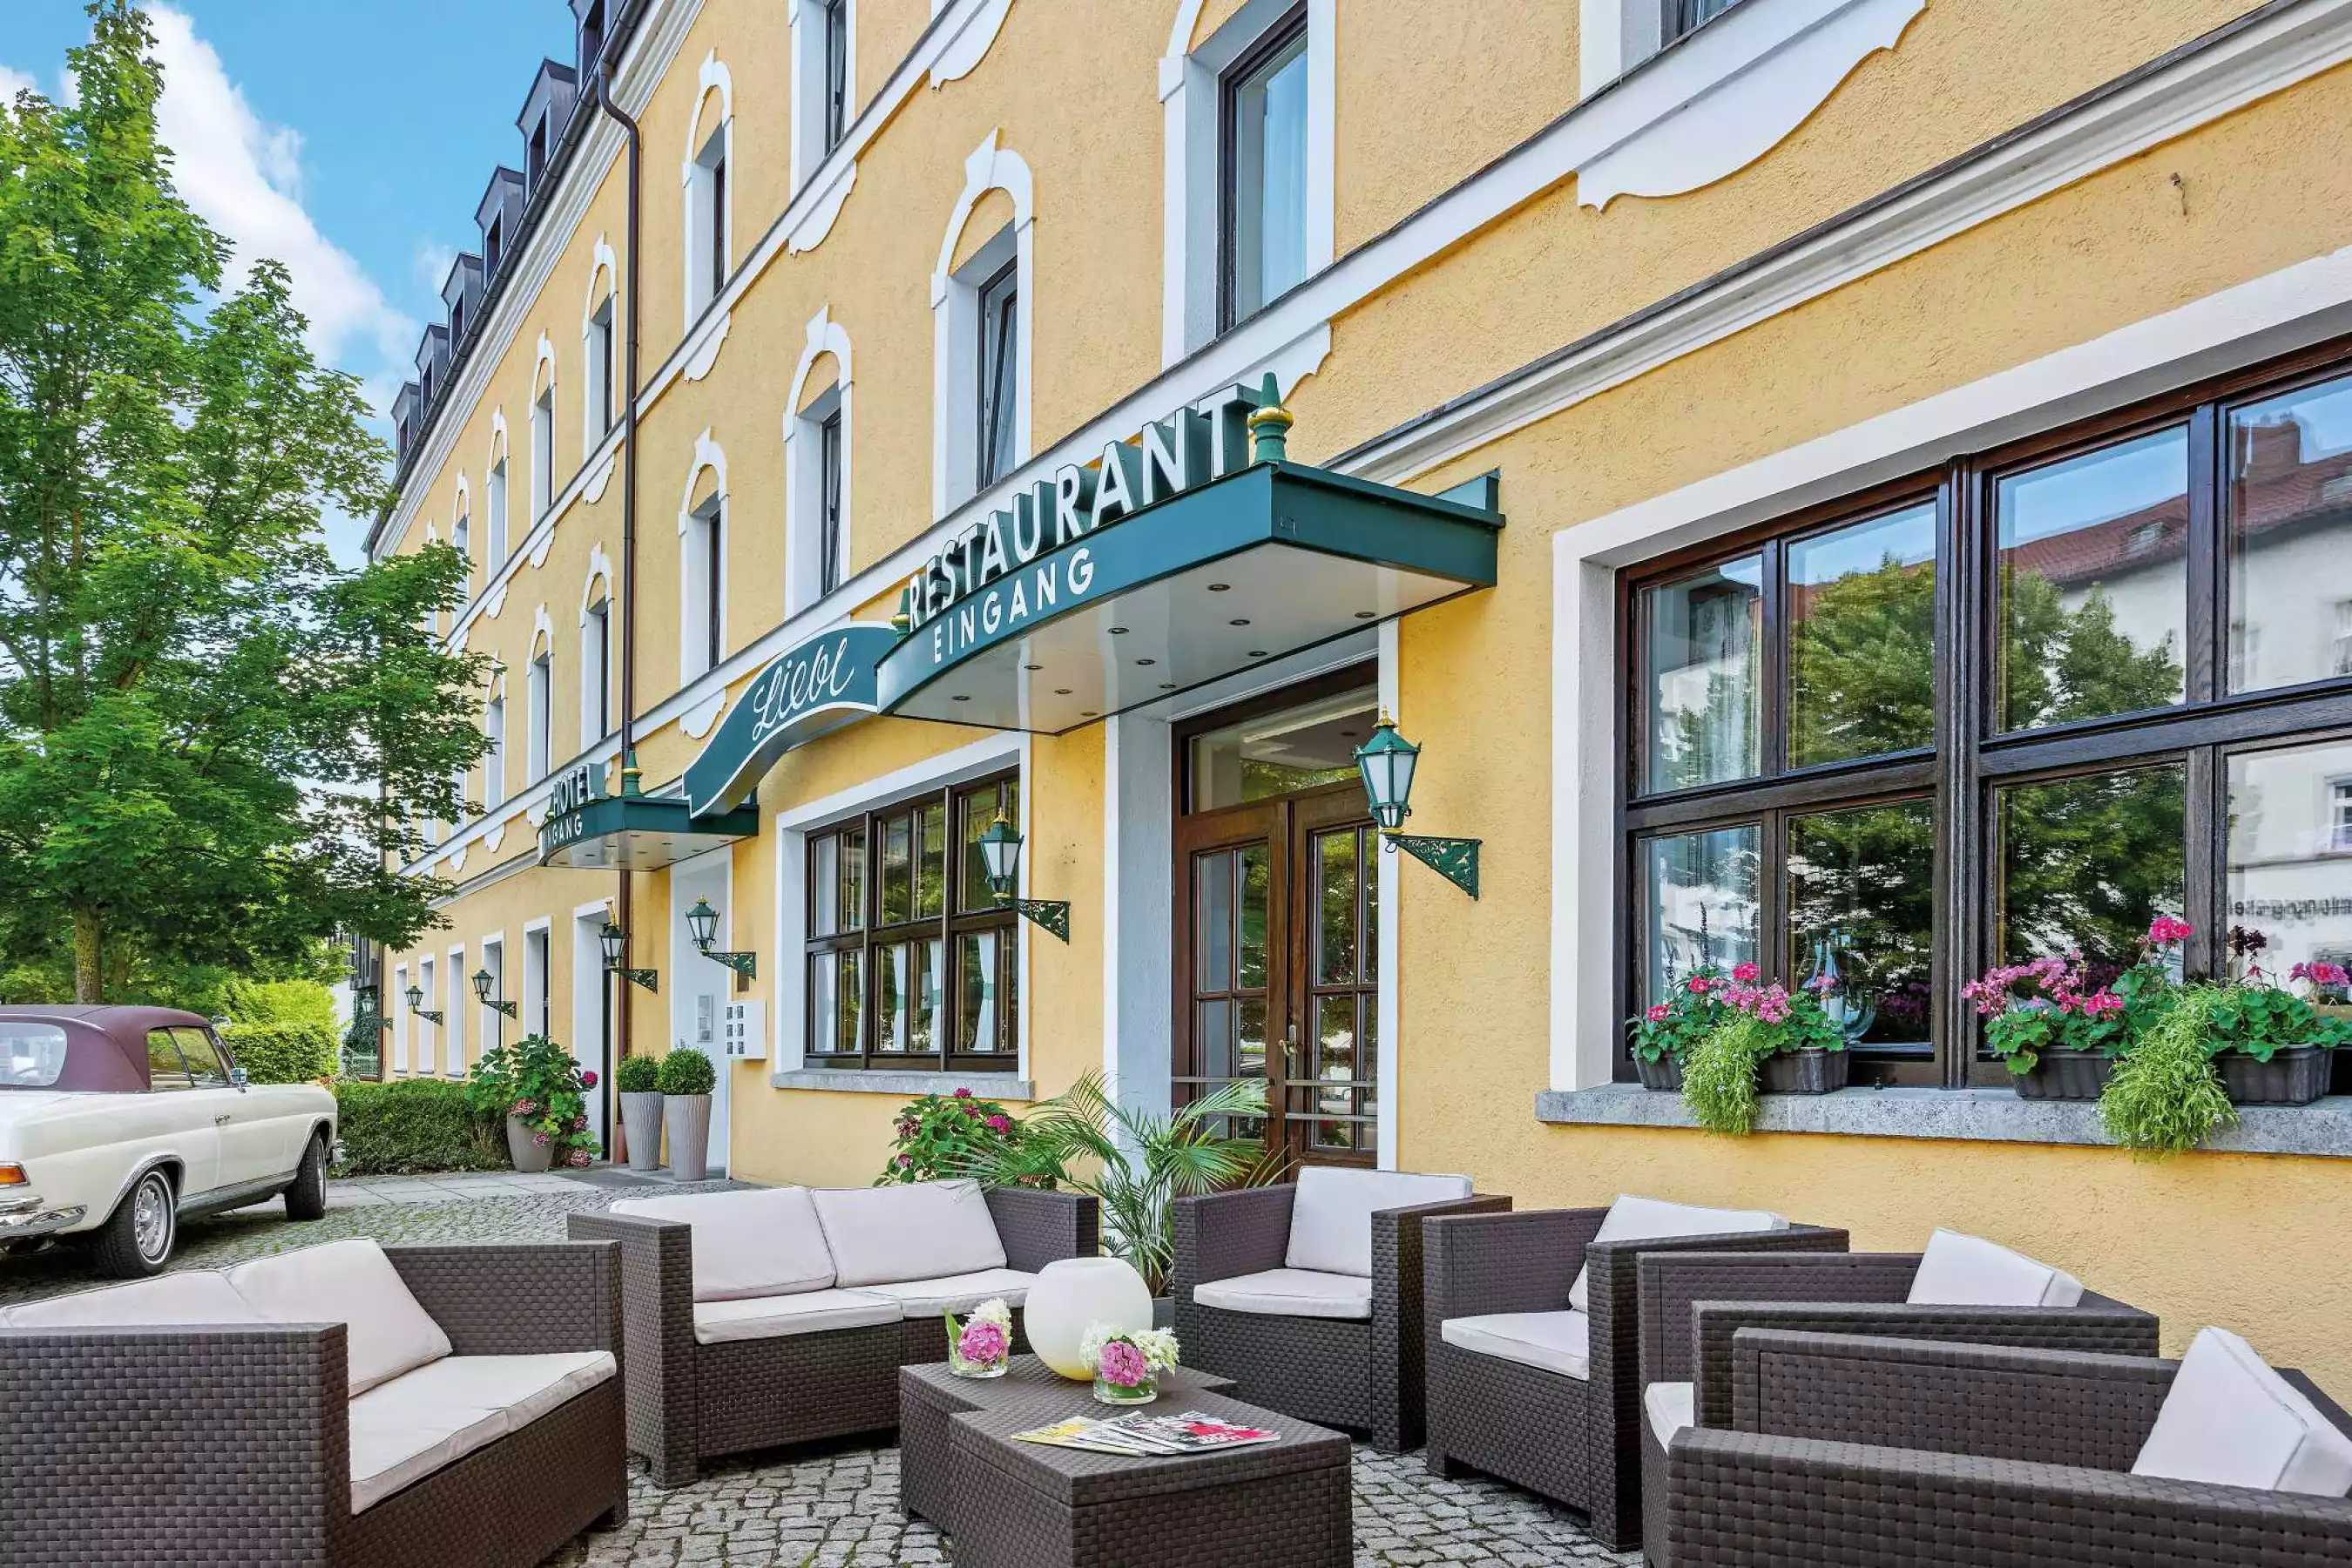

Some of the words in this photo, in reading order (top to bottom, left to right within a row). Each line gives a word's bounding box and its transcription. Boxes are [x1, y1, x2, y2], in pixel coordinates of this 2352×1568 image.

[909, 383, 1254, 633] RESTAURANT
[933, 548, 1095, 663] EINGANG
[753, 637, 855, 741] Liebl
[553, 764, 596, 819] HOTEL
